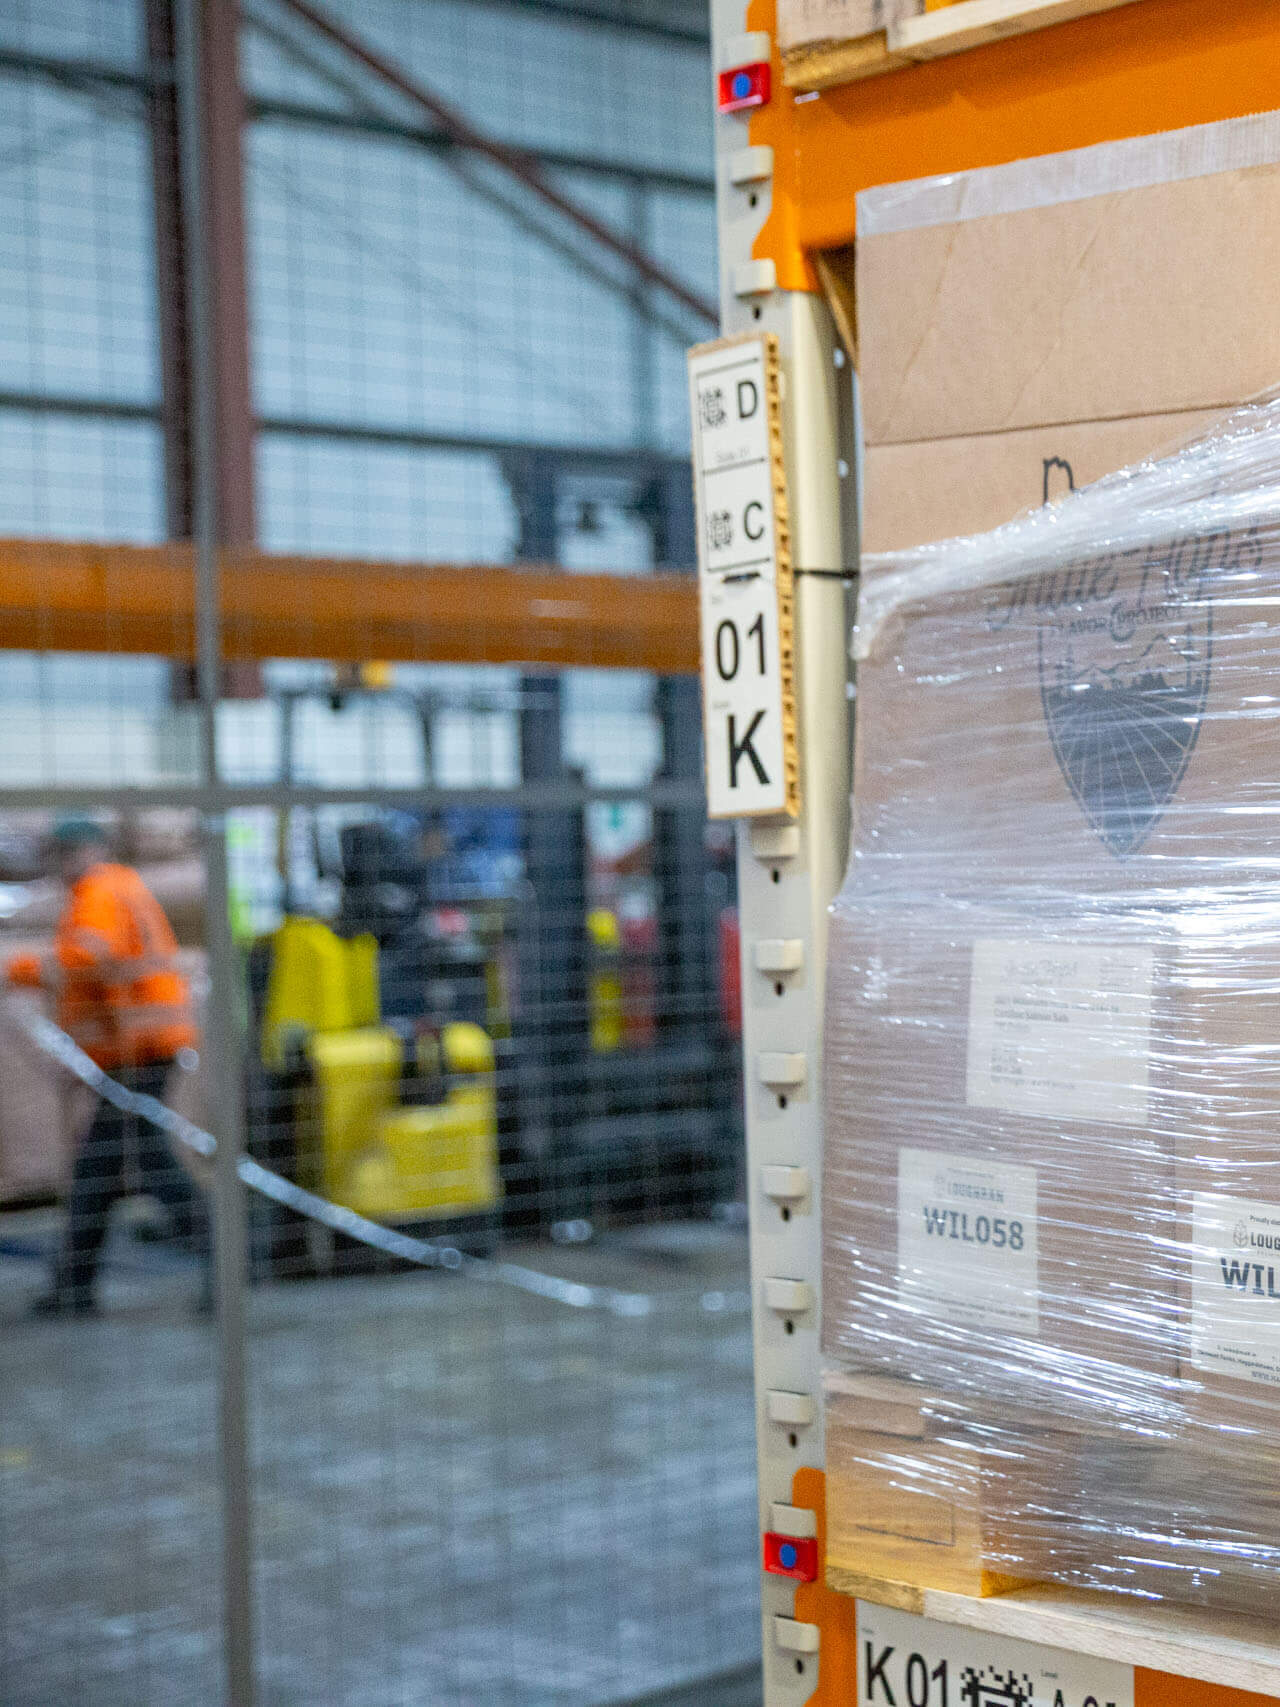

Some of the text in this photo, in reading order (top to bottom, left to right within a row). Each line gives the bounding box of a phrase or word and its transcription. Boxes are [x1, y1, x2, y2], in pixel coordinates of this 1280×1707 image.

[737, 380, 760, 420] D
[743, 501, 765, 542] C
[715, 611, 767, 682] 01
[727, 708, 771, 789] K
[924, 1206, 1024, 1250] WIL058
[865, 1640, 947, 1707] K 01
